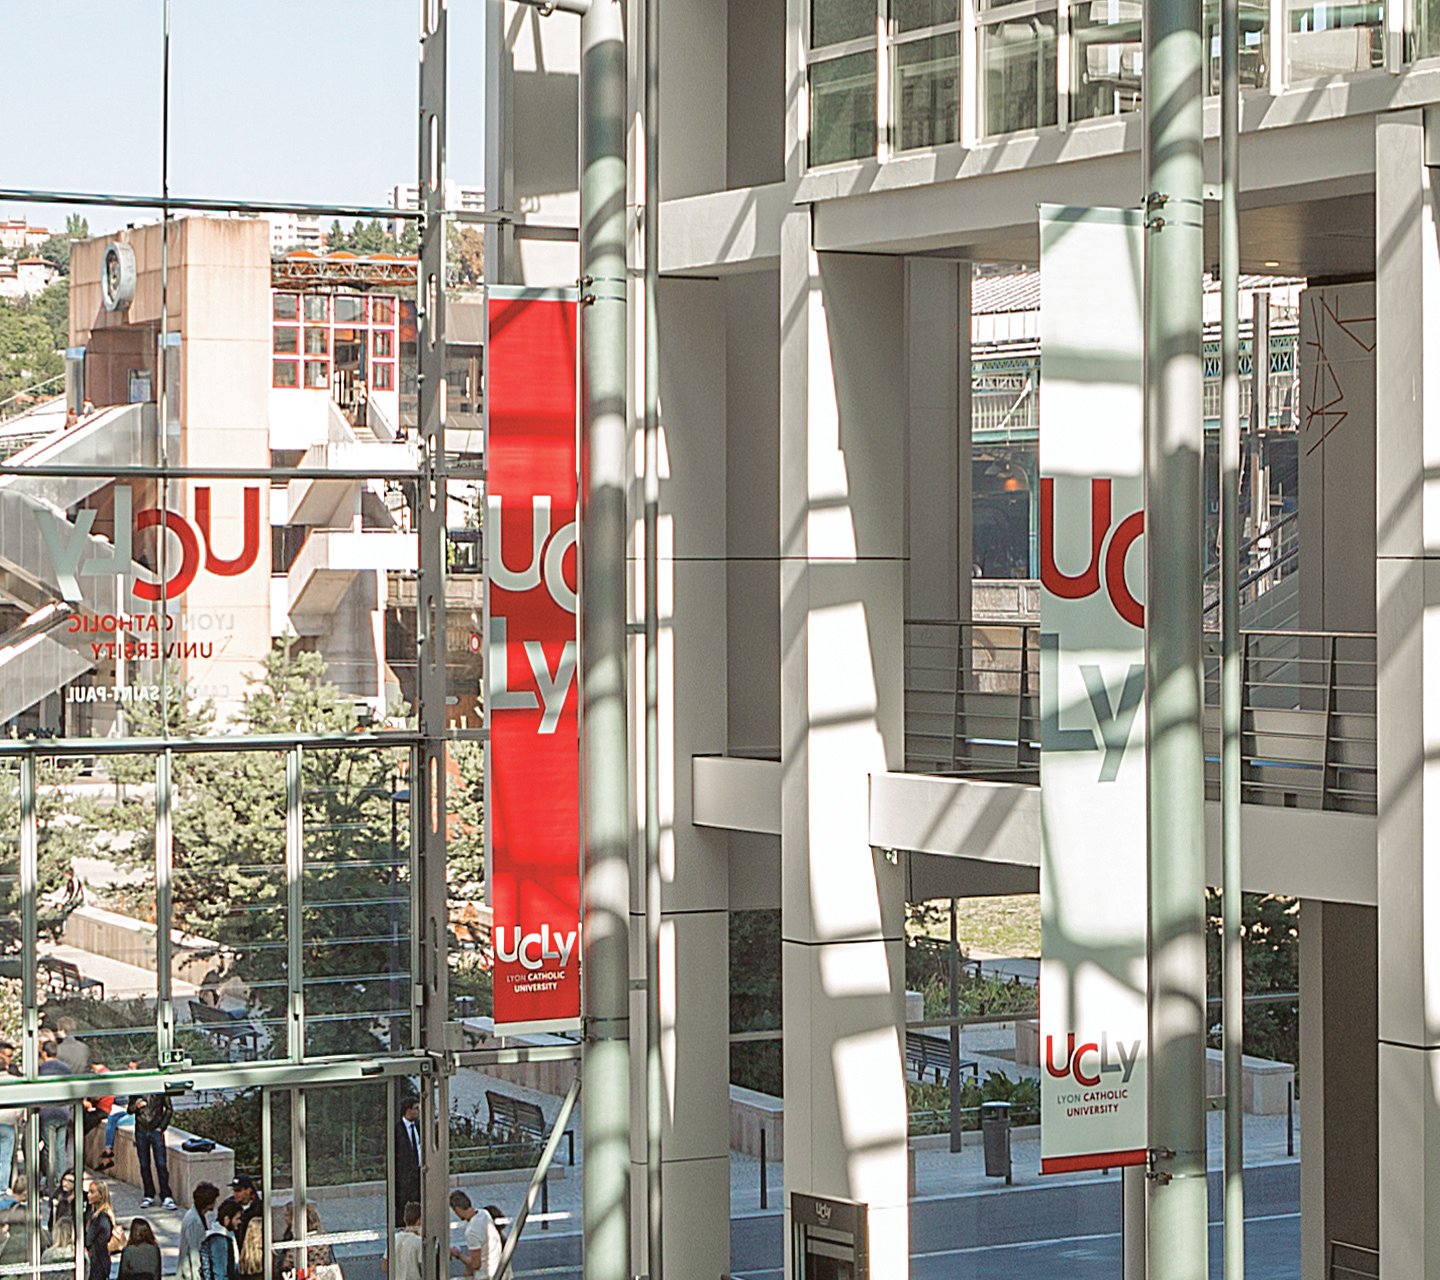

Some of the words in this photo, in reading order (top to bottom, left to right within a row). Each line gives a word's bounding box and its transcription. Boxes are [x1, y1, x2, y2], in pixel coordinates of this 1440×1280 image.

[506, 974, 526, 983] LYON
[527, 971, 565, 981] CATHOLIC
[514, 983, 558, 993] UNIVERSITY
[1057, 1094, 1081, 1105] LYON
[1083, 1089, 1129, 1102] CATHOLIC
[1066, 1104, 1119, 1117] UNIVERSITY
